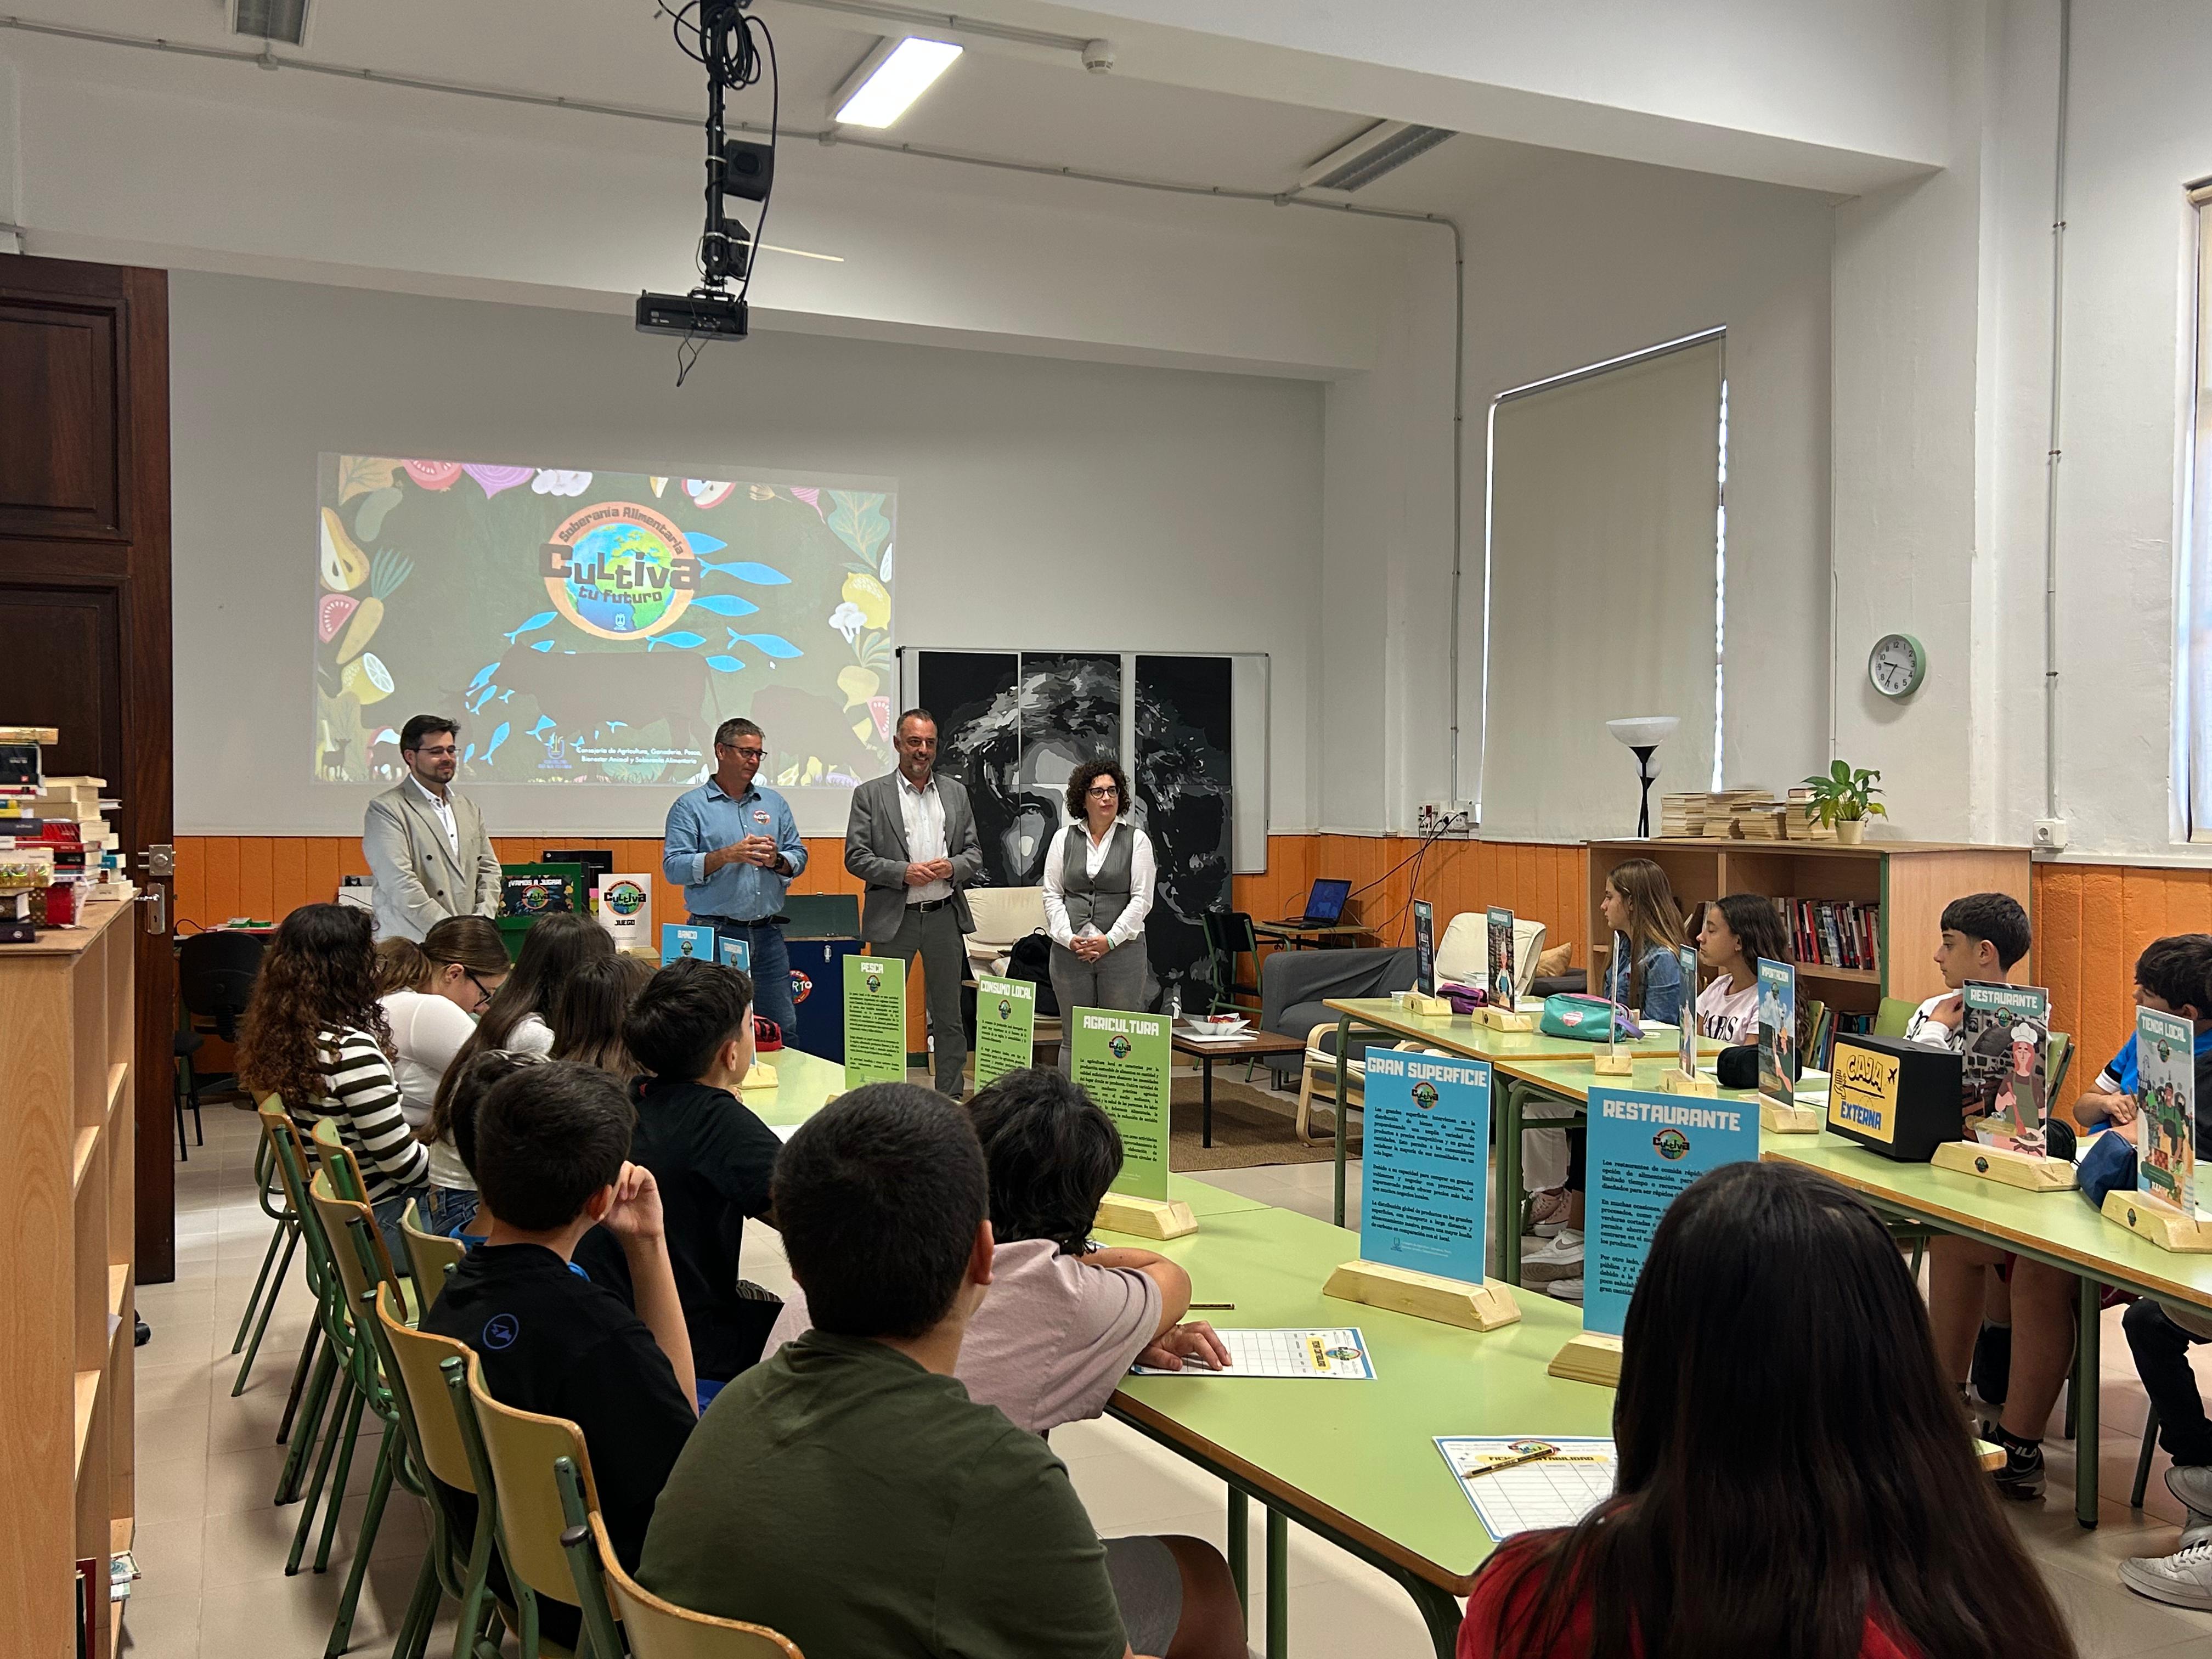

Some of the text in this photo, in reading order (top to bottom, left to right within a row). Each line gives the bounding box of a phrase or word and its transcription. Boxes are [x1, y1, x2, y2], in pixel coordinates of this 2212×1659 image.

[861, 962, 884, 974] PESCA
[981, 980, 1032, 1000] CONSUMO LOCAL
[1971, 989, 2038, 1009] RESTAURANTE
[1083, 1015, 1159, 1036] AGRICULTURA
[2141, 1016, 2186, 1042] TIENDA LOCAL
[1367, 1057, 1487, 1087] GRAN SUPERFICIE
[1847, 1054, 1883, 1094] CAJA
[1603, 1099, 1740, 1131] RESTAURANTE
[1841, 1101, 1881, 1130] EXTERNA
[1639, 1172, 1674, 1182] alimentación
